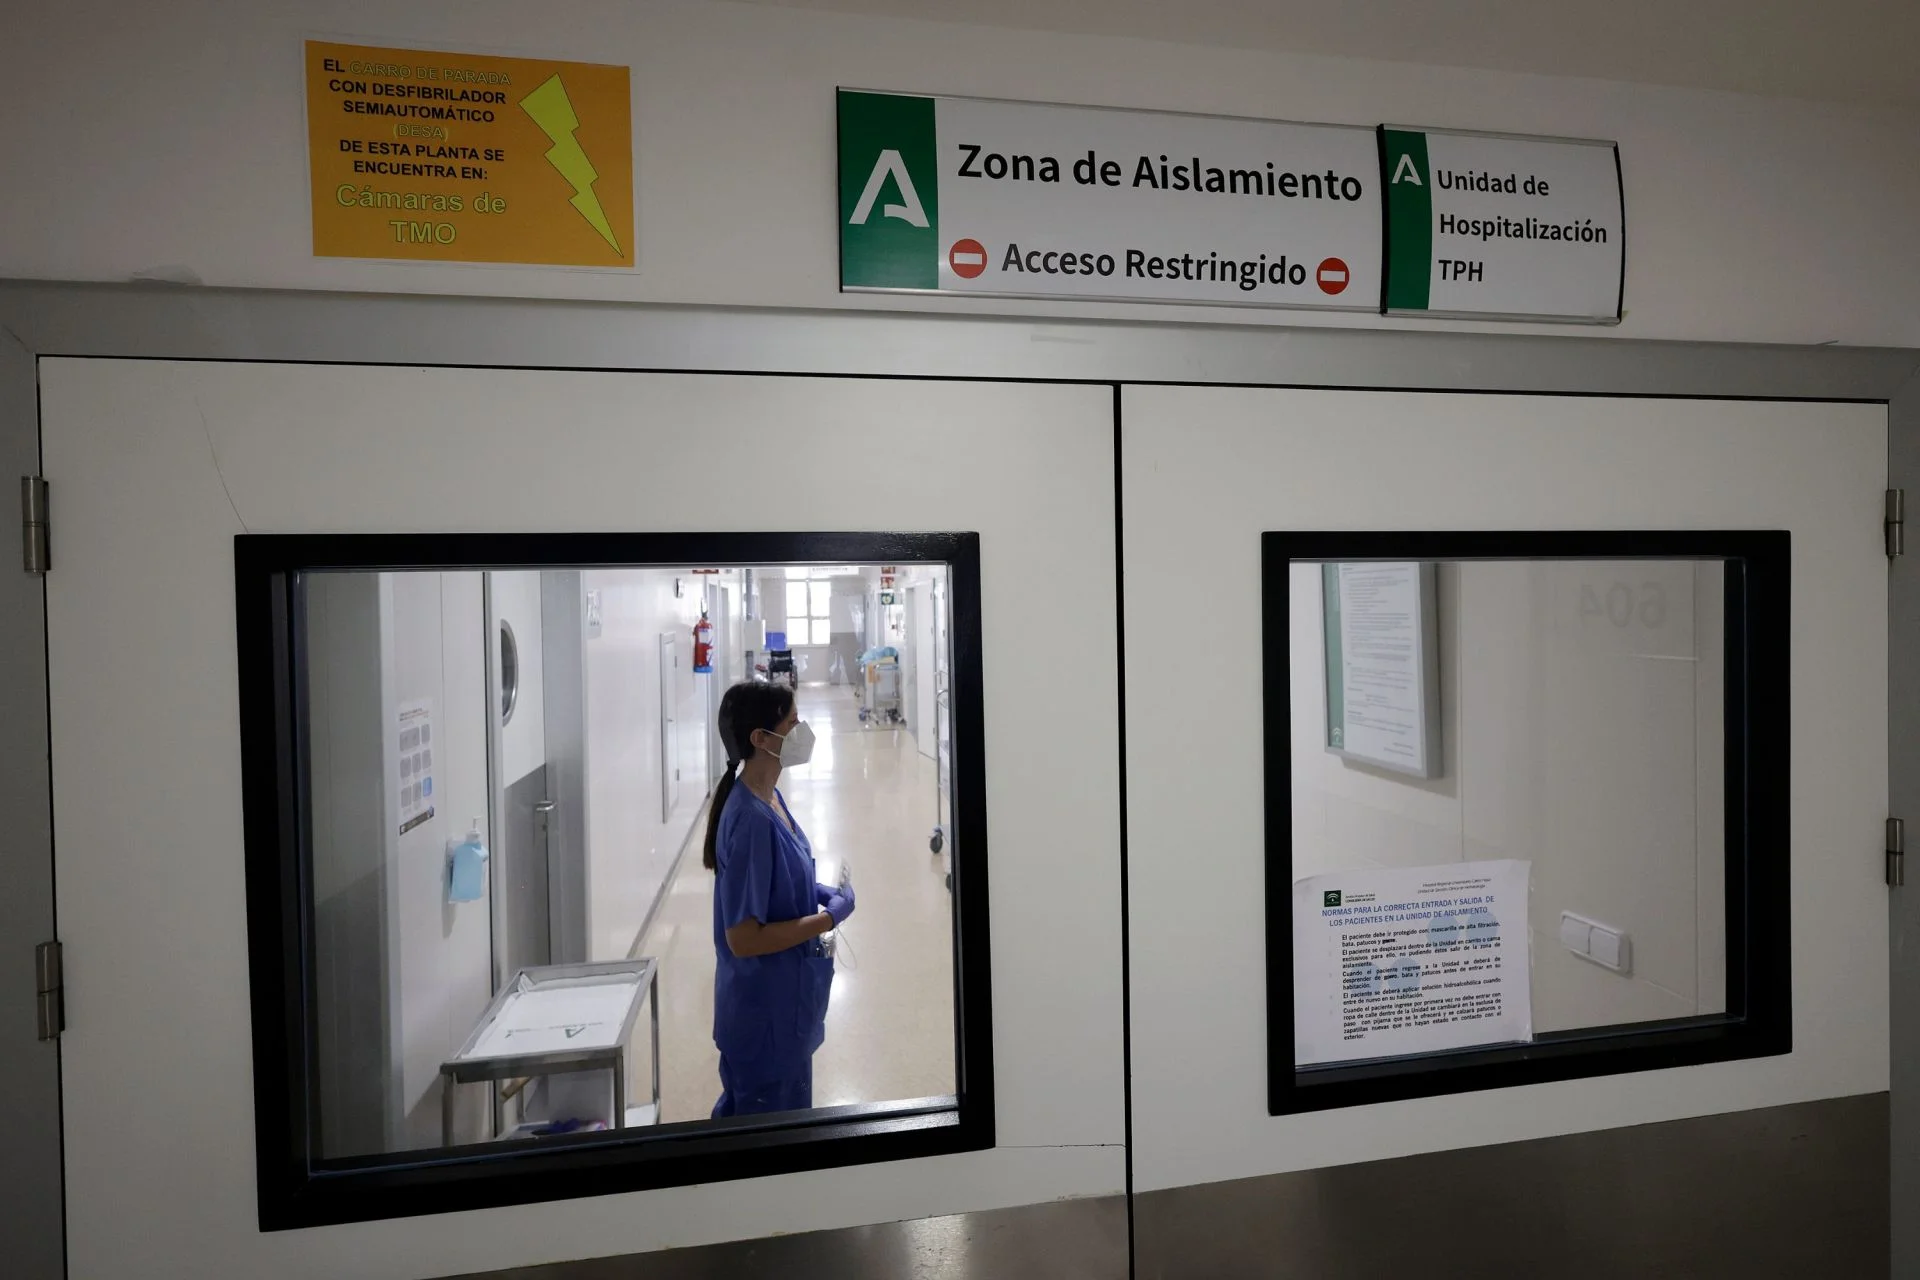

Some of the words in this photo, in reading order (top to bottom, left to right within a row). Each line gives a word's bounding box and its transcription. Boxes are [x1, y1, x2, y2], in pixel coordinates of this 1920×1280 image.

[324, 59, 345, 72] EL
[350, 61, 411, 79] CARRO
[417, 66, 438, 81] DE
[444, 69, 511, 85] PARADA
[329, 80, 366, 95] CON
[372, 82, 506, 104] DESFIBRILADOR
[344, 100, 494, 122] SEMIAUTOMÁTICO
[393, 124, 448, 142] (DESA)
[340, 140, 362, 153] DE
[368, 142, 410, 156] ESTA
[416, 145, 479, 160] PLANTA
[484, 149, 504, 162] SE
[354, 161, 457, 178] ENCUENTRA
[462, 167, 487, 180] EN:
[958, 144, 1061, 183] Zona
[1073, 151, 1121, 187] de
[1133, 155, 1362, 202] Aislamiento
[1437, 170, 1516, 194] Unidad
[1523, 176, 1549, 195] de
[336, 184, 464, 212] Cámaras
[474, 192, 506, 213] de
[390, 221, 456, 244] TMO
[1440, 213, 1607, 243] Hospitalización
[1002, 243, 1115, 277] Acceso
[1126, 249, 1306, 291] Restringido
[1439, 259, 1483, 281] TPH
[1322, 908, 1352, 916] NORMAS
[1384, 903, 1419, 911] CORRECTA
[1422, 900, 1452, 908] ENTRADA
[1460, 897, 1482, 905] SALIDA
[1345, 916, 1382, 925] PACIENTES
[1406, 912, 1431, 920] UNIDAD
[1444, 907, 1487, 917] AISLAMIENTO
